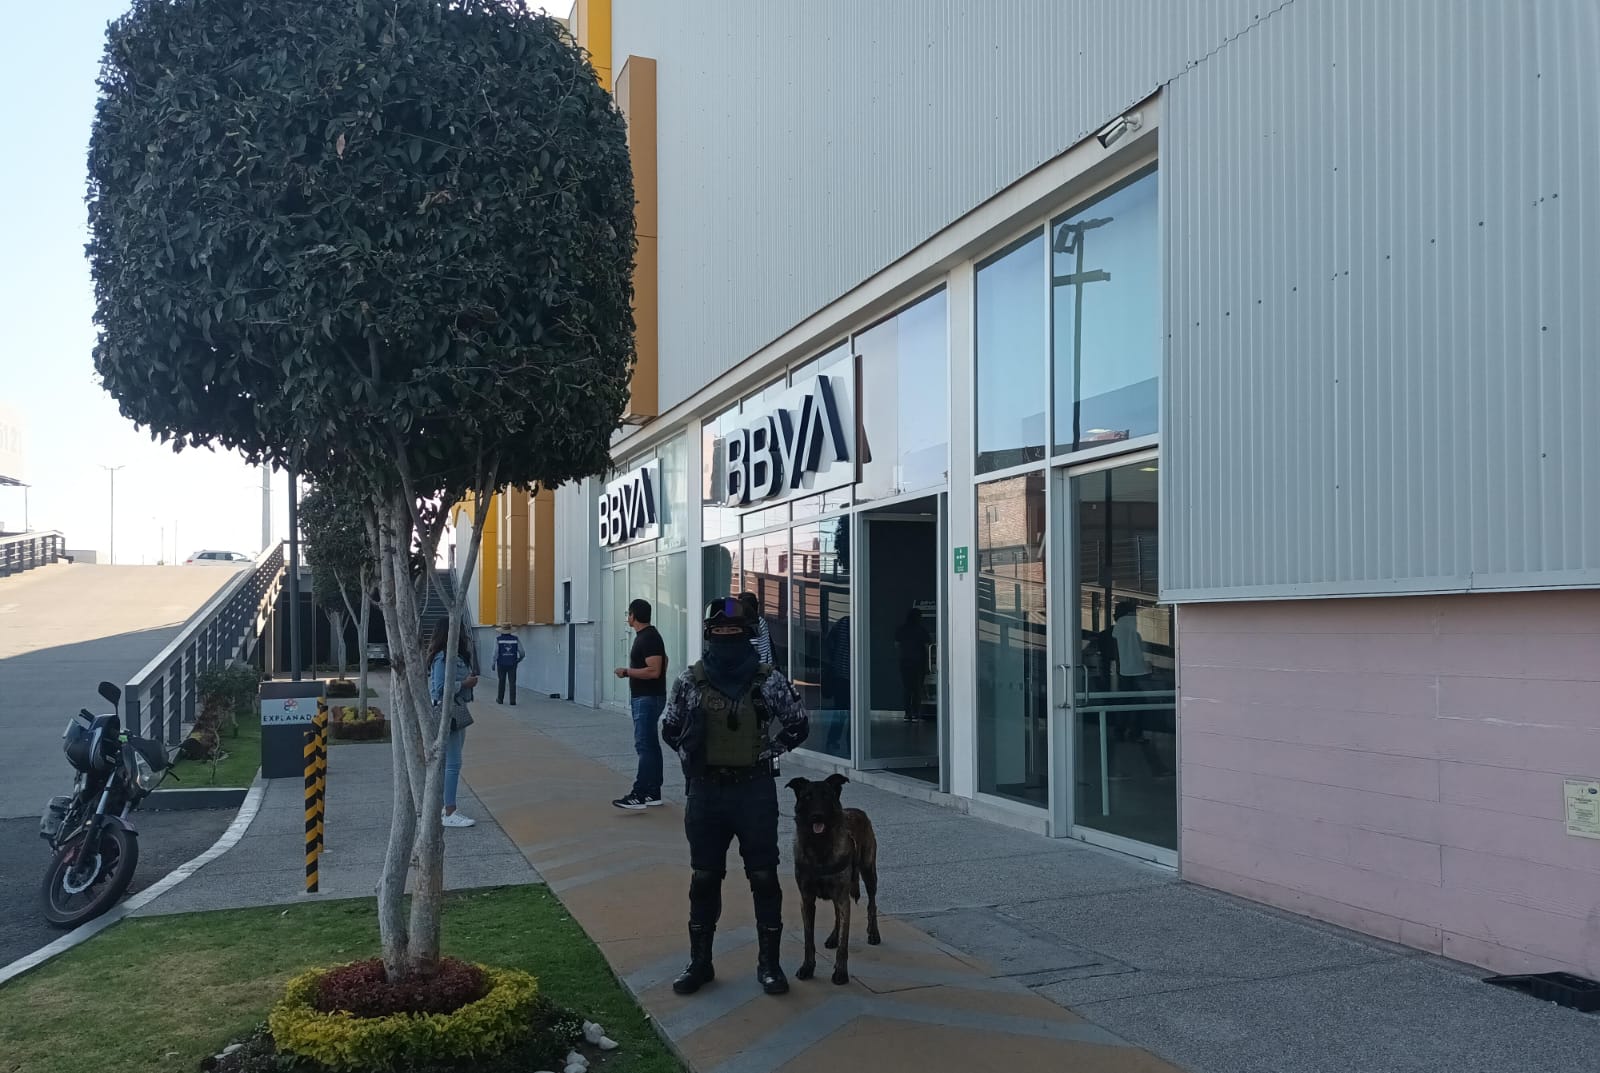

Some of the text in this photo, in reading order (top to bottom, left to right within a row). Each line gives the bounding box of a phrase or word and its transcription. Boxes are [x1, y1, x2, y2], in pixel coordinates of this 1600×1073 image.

[726, 375, 850, 507] BBVA
[599, 468, 657, 547] BBVA
[263, 714, 317, 722] EXPLANAD
